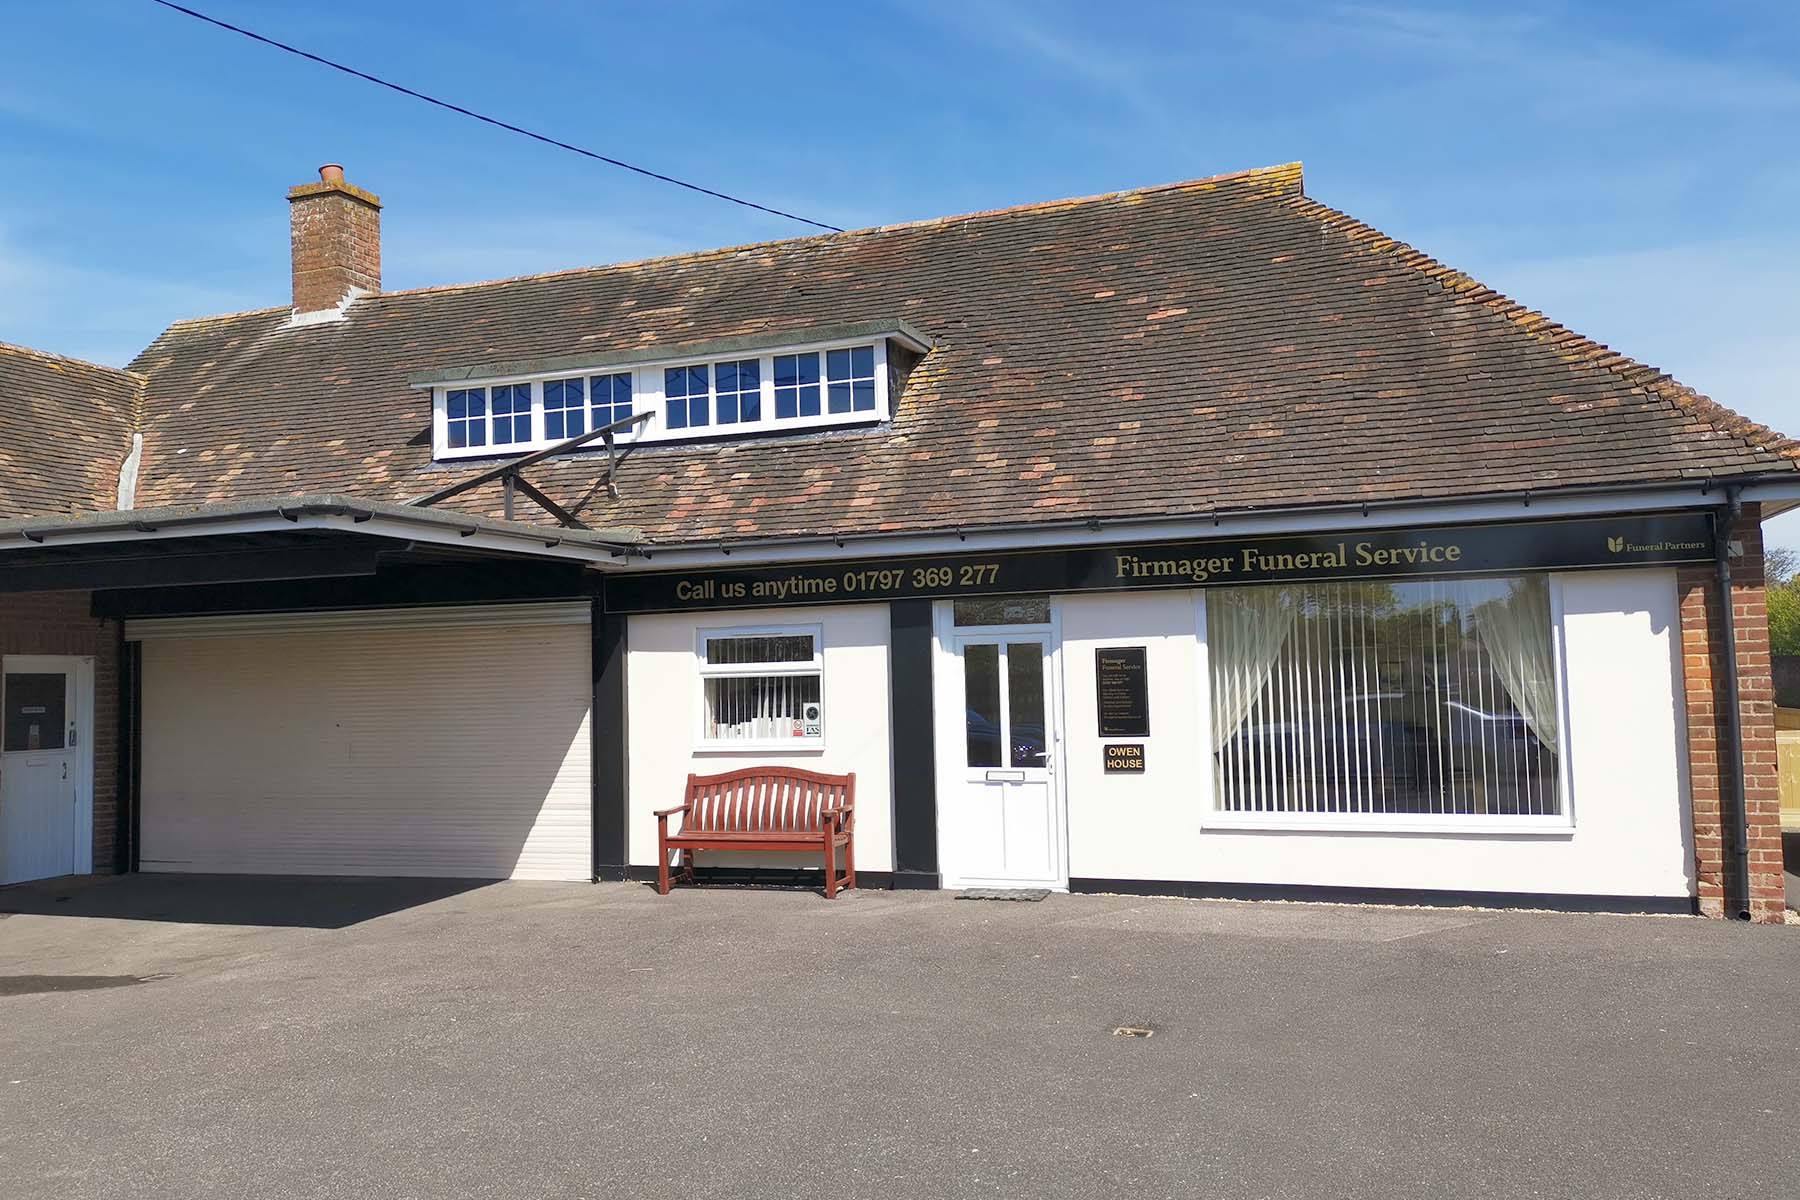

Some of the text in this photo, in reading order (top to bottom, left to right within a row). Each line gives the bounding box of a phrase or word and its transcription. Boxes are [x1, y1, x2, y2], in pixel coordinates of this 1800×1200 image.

[1626, 541, 1705, 552] Funeral Partners
[1115, 541, 1462, 581] Firmager Funeral Service
[676, 564, 1000, 600] Call us anytime 01797 369 277
[1108, 747, 1141, 756] OWEN
[1107, 759, 1143, 769] HOUSE
